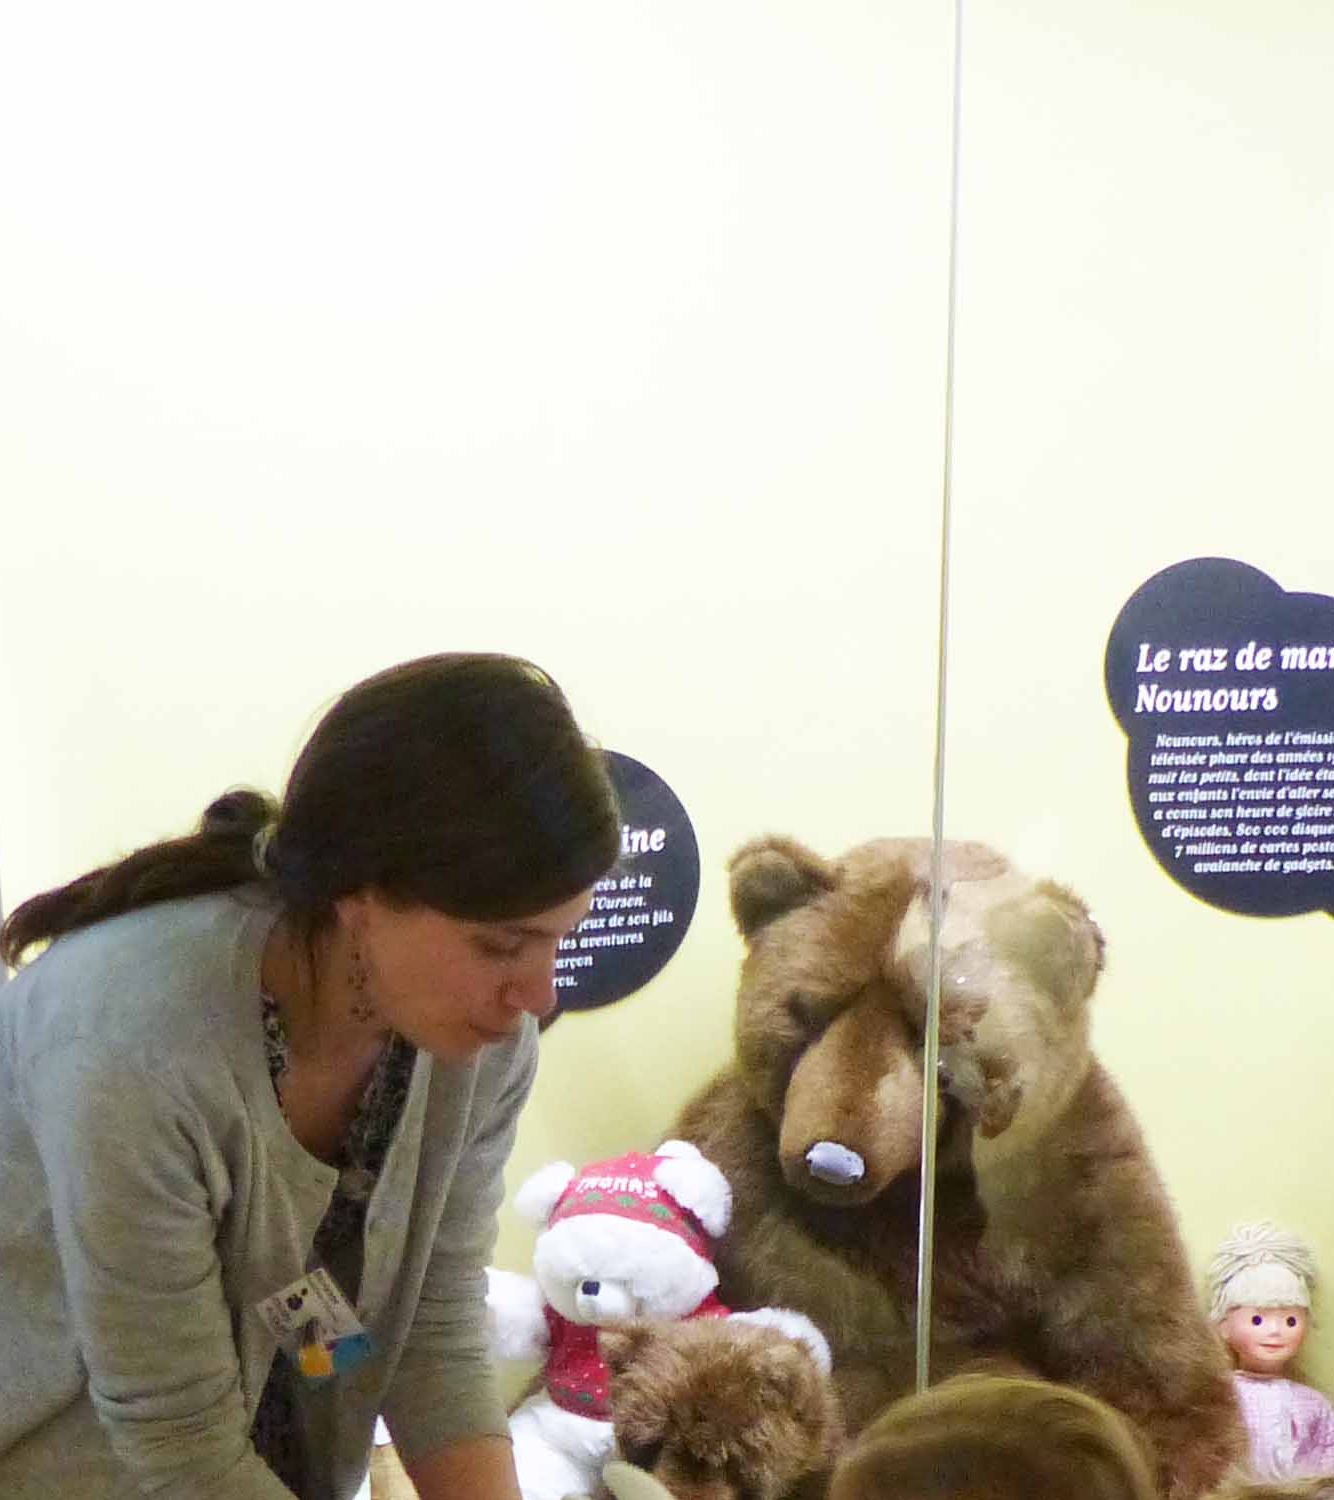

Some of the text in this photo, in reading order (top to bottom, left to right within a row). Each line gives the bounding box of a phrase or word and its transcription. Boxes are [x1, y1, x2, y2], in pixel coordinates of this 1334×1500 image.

[1136, 642, 1172, 673] Le
[1178, 647, 1229, 672] raz
[1234, 640, 1273, 671] de
[1134, 683, 1279, 713] Nounours
[1226, 732, 1263, 746] héros
[1265, 732, 1282, 745] de
[1150, 751, 1207, 767] télévisée
[1208, 751, 1248, 768] phare
[1250, 750, 1273, 764] des
[1275, 749, 1324, 763] années
[1147, 771, 1178, 784] nuit
[1178, 769, 1198, 784] les
[1243, 768, 1275, 782] dont
[1277, 767, 1314, 781] l'idée
[1149, 790, 1175, 803] aux
[1177, 788, 1228, 804] enfants
[1231, 787, 1274, 800] l'envie
[1276, 785, 1320, 799] d'aller
[1153, 809, 1163, 820] a
[1165, 808, 1207, 820] connu
[1210, 807, 1233, 819] son
[1236, 805, 1275, 818] heure
[1276, 804, 1294, 818] de
[620, 823, 667, 854] ine
[1236, 823, 1261, 836] 800
[1263, 824, 1289, 836] 000
[1174, 844, 1184, 859] 7
[1185, 841, 1238, 855] millions
[1240, 841, 1258, 854] de
[1259, 841, 1300, 854] cartes
[1193, 859, 1263, 873] avalanche
[1263, 858, 1281, 871] de
[595, 873, 653, 892] cès de la
[577, 909, 674, 934] jeux de son fils
[558, 932, 644, 951] les aventures
[554, 955, 593, 971] arçon
[553, 975, 578, 988] rou.
